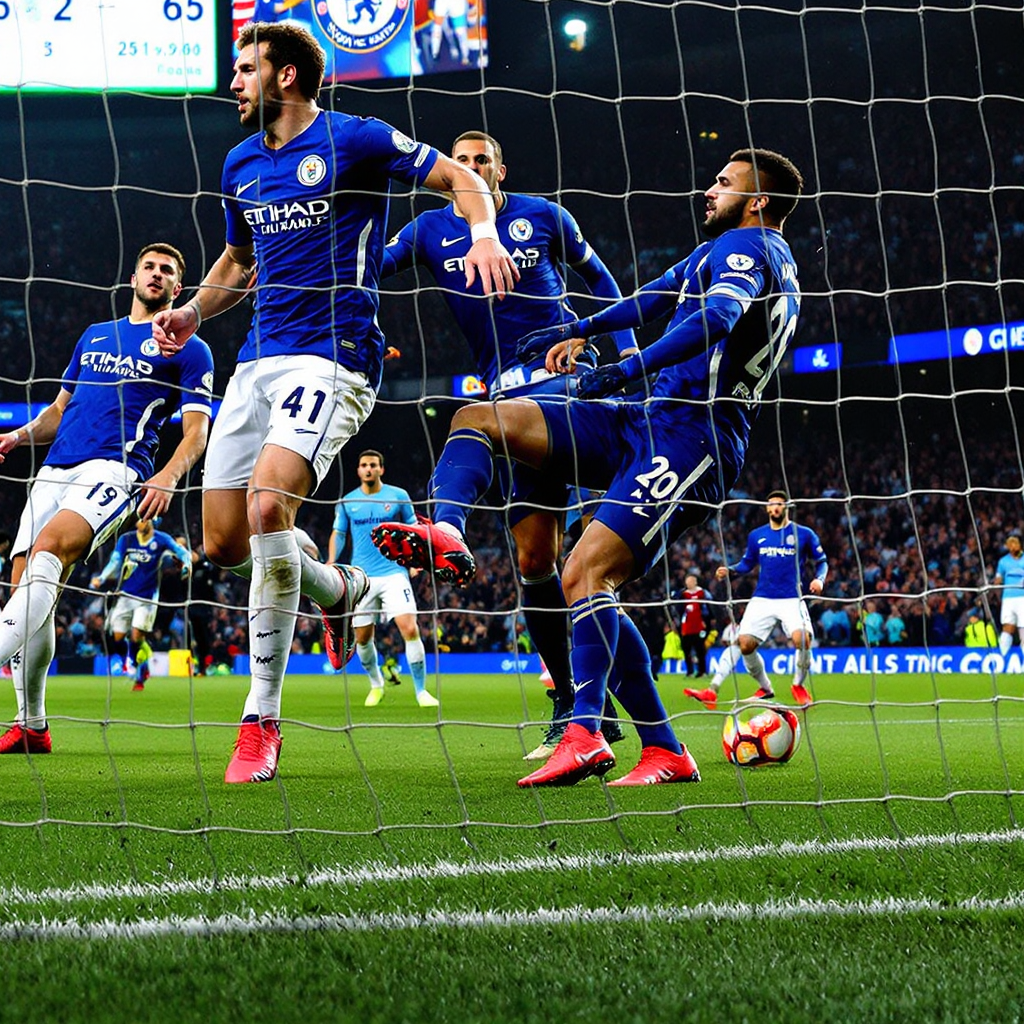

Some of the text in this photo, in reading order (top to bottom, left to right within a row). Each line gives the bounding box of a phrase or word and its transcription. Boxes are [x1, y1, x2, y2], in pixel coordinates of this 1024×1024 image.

[243, 199, 330, 226] ETIHAD
[281, 386, 326, 424] 41
[634, 455, 679, 499] 20
[86, 482, 118, 507] 19
[843, 654, 899, 674] ALLS
